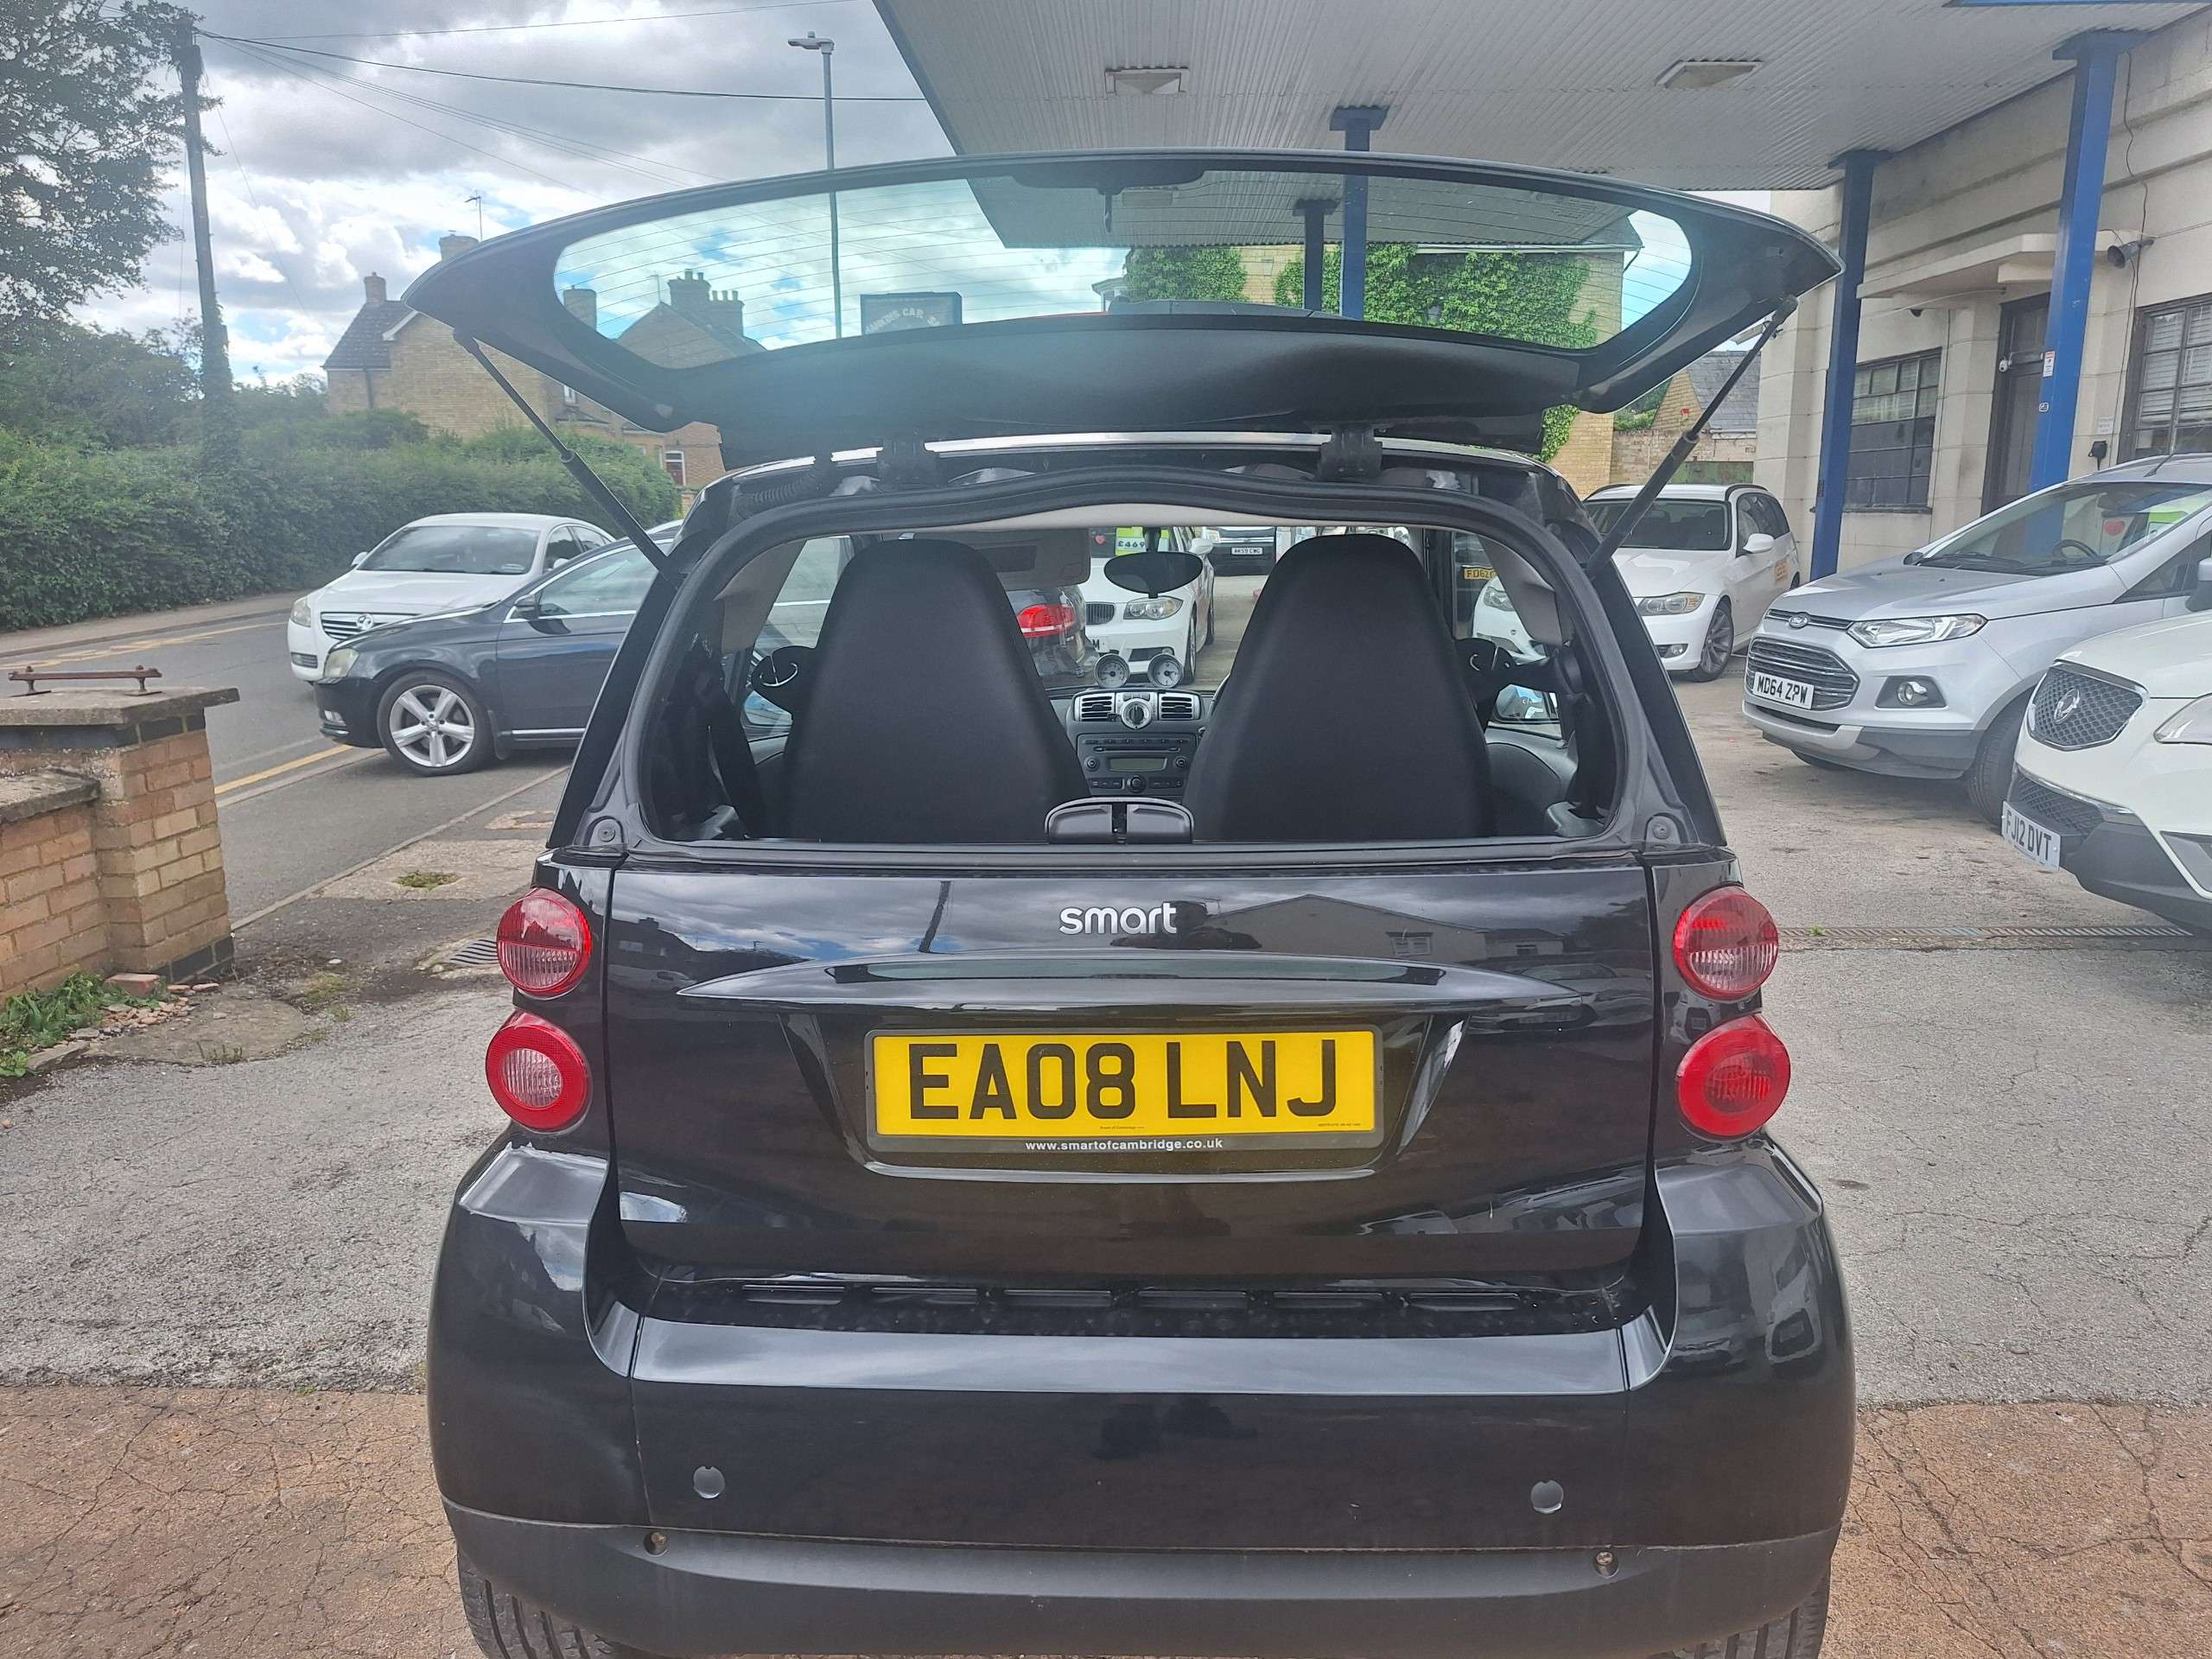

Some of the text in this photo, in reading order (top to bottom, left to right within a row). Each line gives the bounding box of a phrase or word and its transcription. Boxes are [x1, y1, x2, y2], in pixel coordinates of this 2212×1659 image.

[1758, 676, 1808, 703] MD64 ZPW
[2005, 810, 2052, 861] FJ12 DVT
[1059, 902, 1178, 935] smart
[909, 1039, 1337, 1120] EA08 LNJ
[1025, 1137, 1224, 1152] www.smartofcambridge.co.uk
